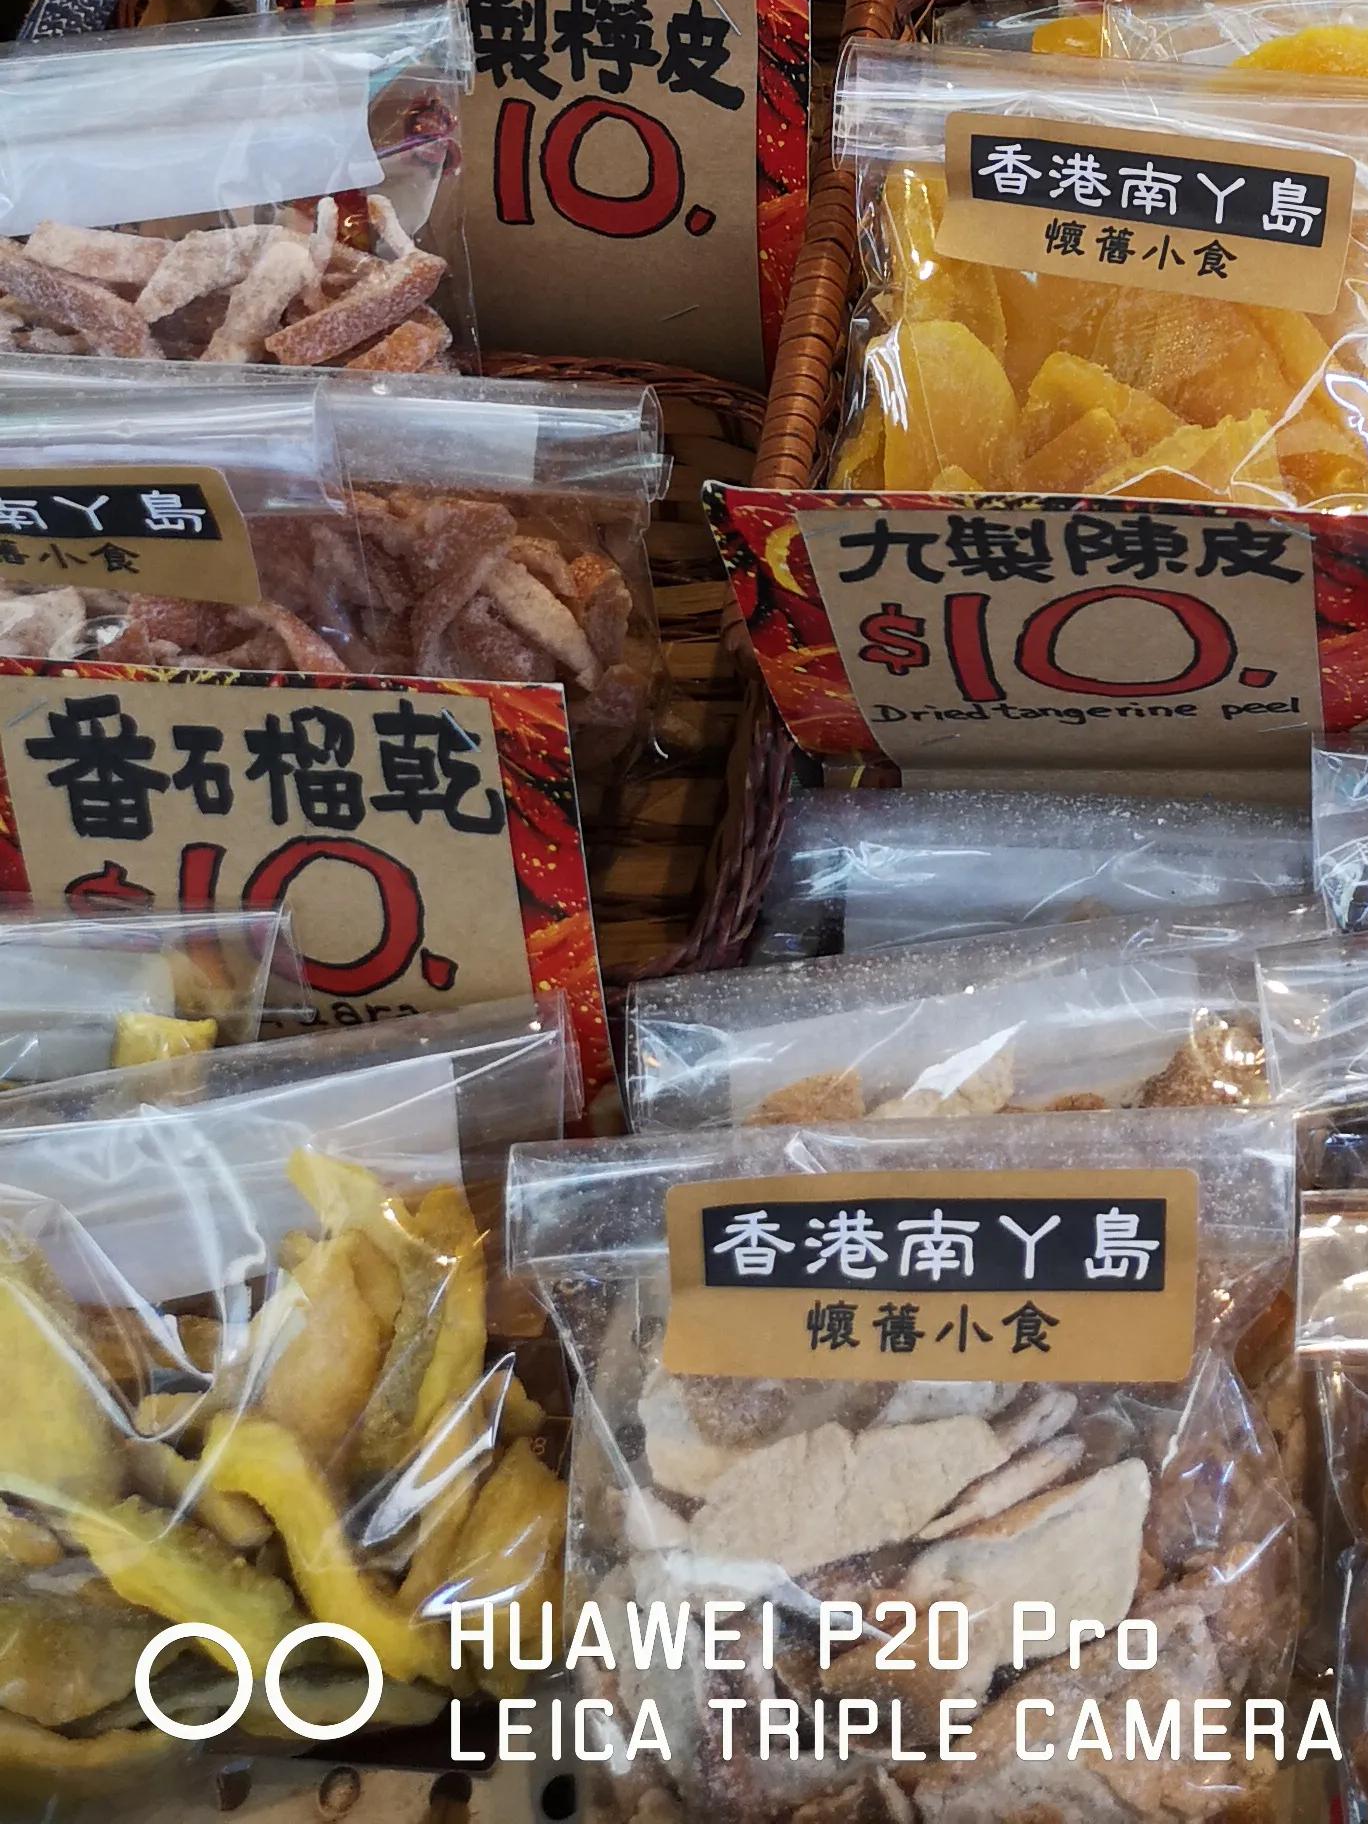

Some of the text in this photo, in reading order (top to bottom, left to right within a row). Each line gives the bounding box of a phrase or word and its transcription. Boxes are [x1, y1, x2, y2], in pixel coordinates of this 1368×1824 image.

[978, 143, 1323, 238] 香港南丫島
[1045, 217, 1238, 280] 懷舊小食
[857, 584, 1278, 702] $10.
[872, 695, 1301, 725] Dried tangerine peel
[26, 694, 505, 841] 番石榴乾
[714, 1207, 1161, 1281] 香港南丫島
[807, 1300, 1061, 1354] 懷舊小食
